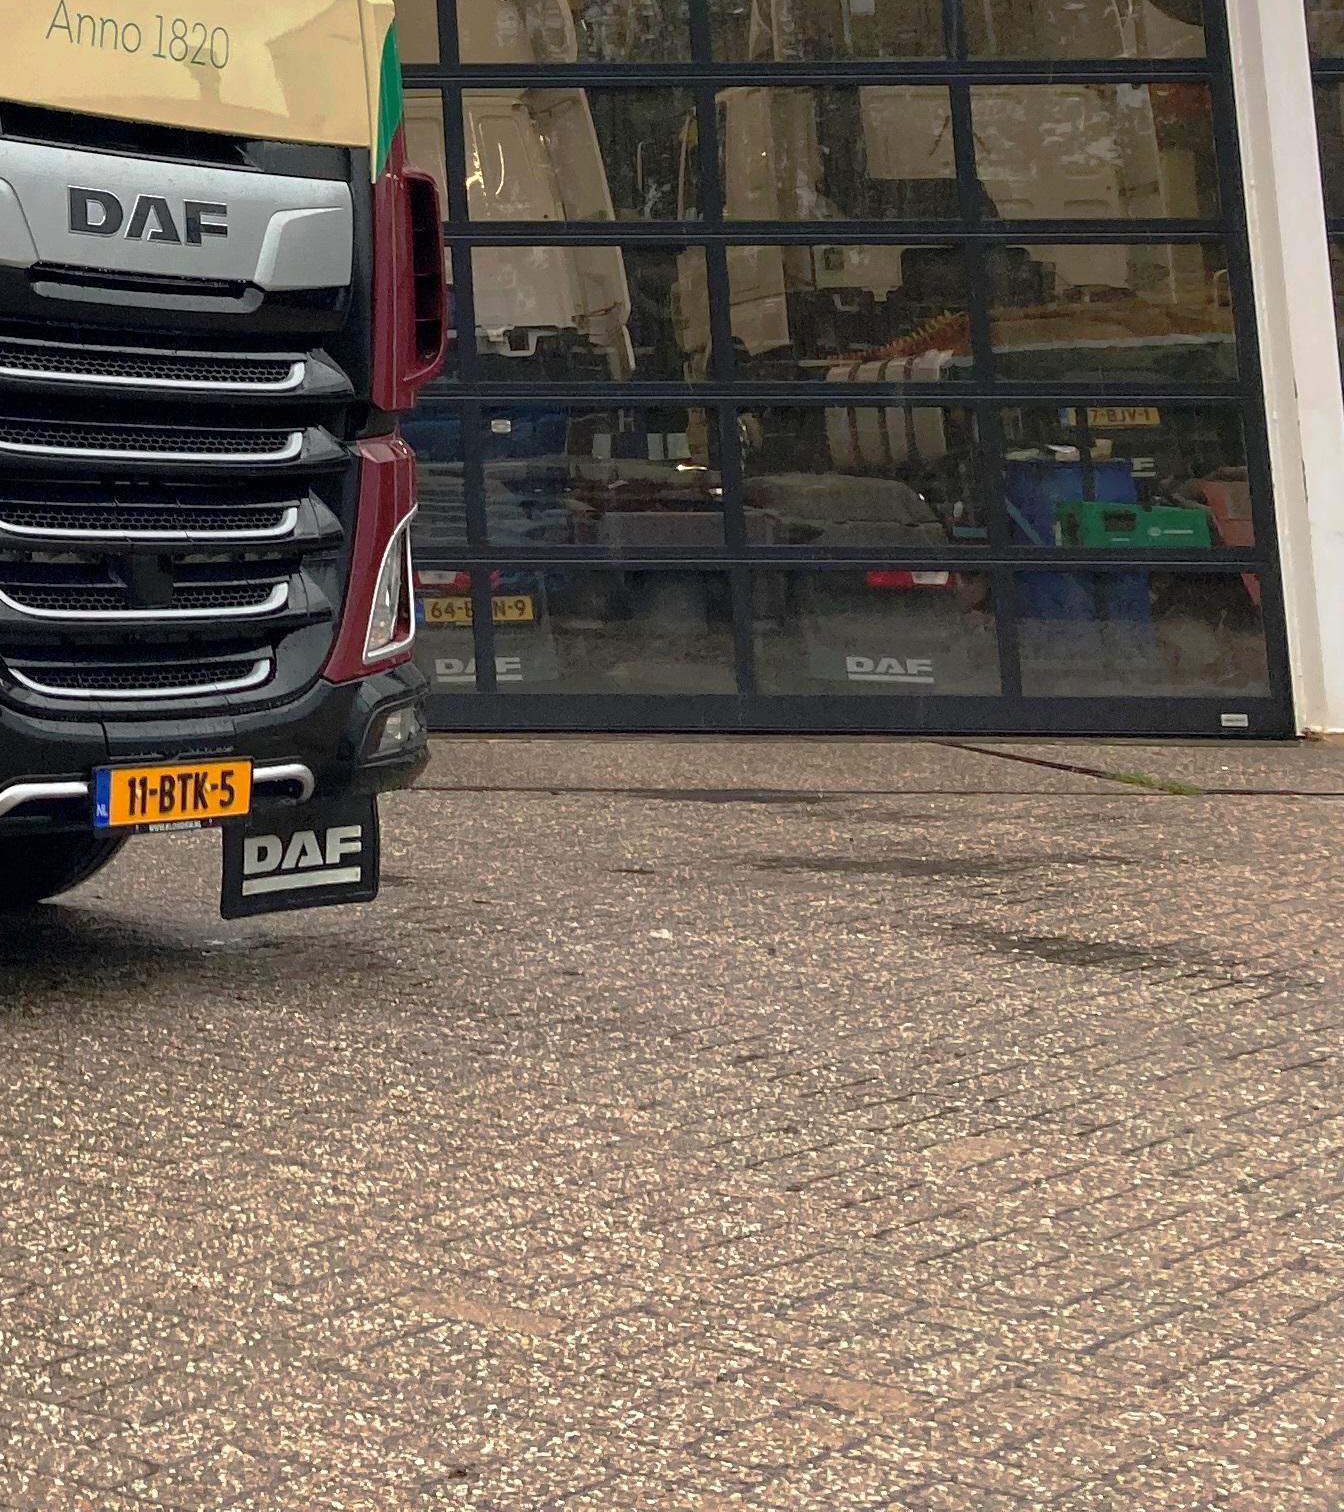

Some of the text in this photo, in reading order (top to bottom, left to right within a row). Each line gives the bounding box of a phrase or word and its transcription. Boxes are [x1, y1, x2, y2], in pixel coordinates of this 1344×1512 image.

[152, 14, 230, 69] 1820
[67, 184, 228, 247] DAF
[431, 598, 527, 619] 64-BN-9
[846, 656, 933, 675] DAF
[96, 769, 236, 817] NL 11-BTK-5
[243, 824, 363, 875] DAF
